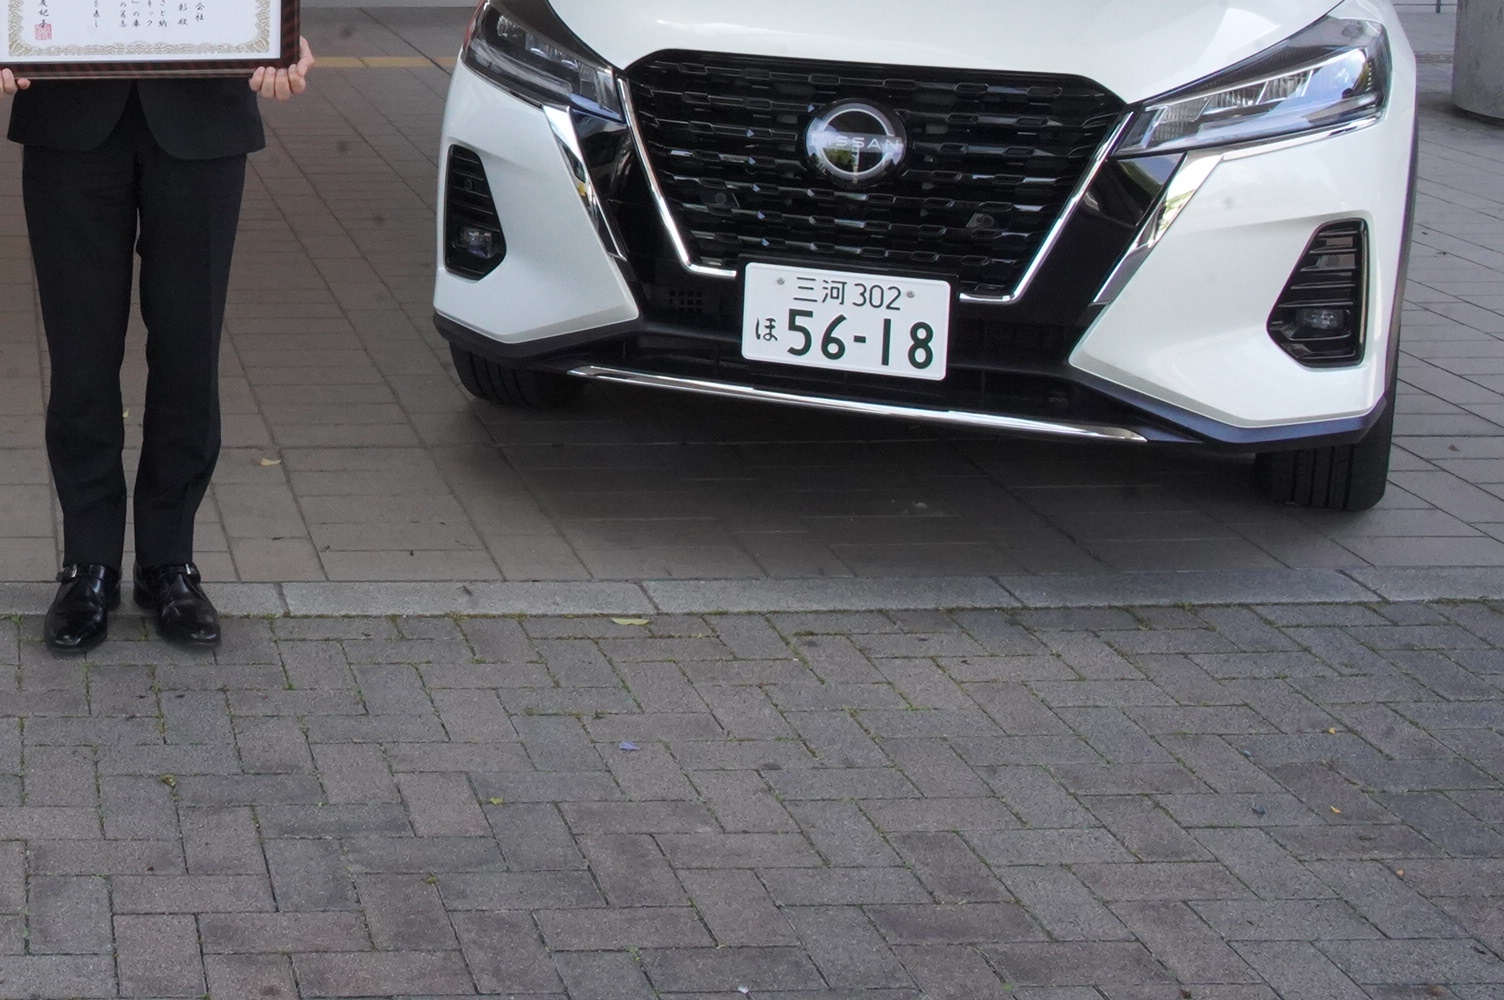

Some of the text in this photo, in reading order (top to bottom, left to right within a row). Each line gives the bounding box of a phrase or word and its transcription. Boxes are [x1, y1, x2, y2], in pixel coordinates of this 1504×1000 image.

[811, 133, 900, 152] SSAN
[755, 308, 934, 370] ほ 56-18
